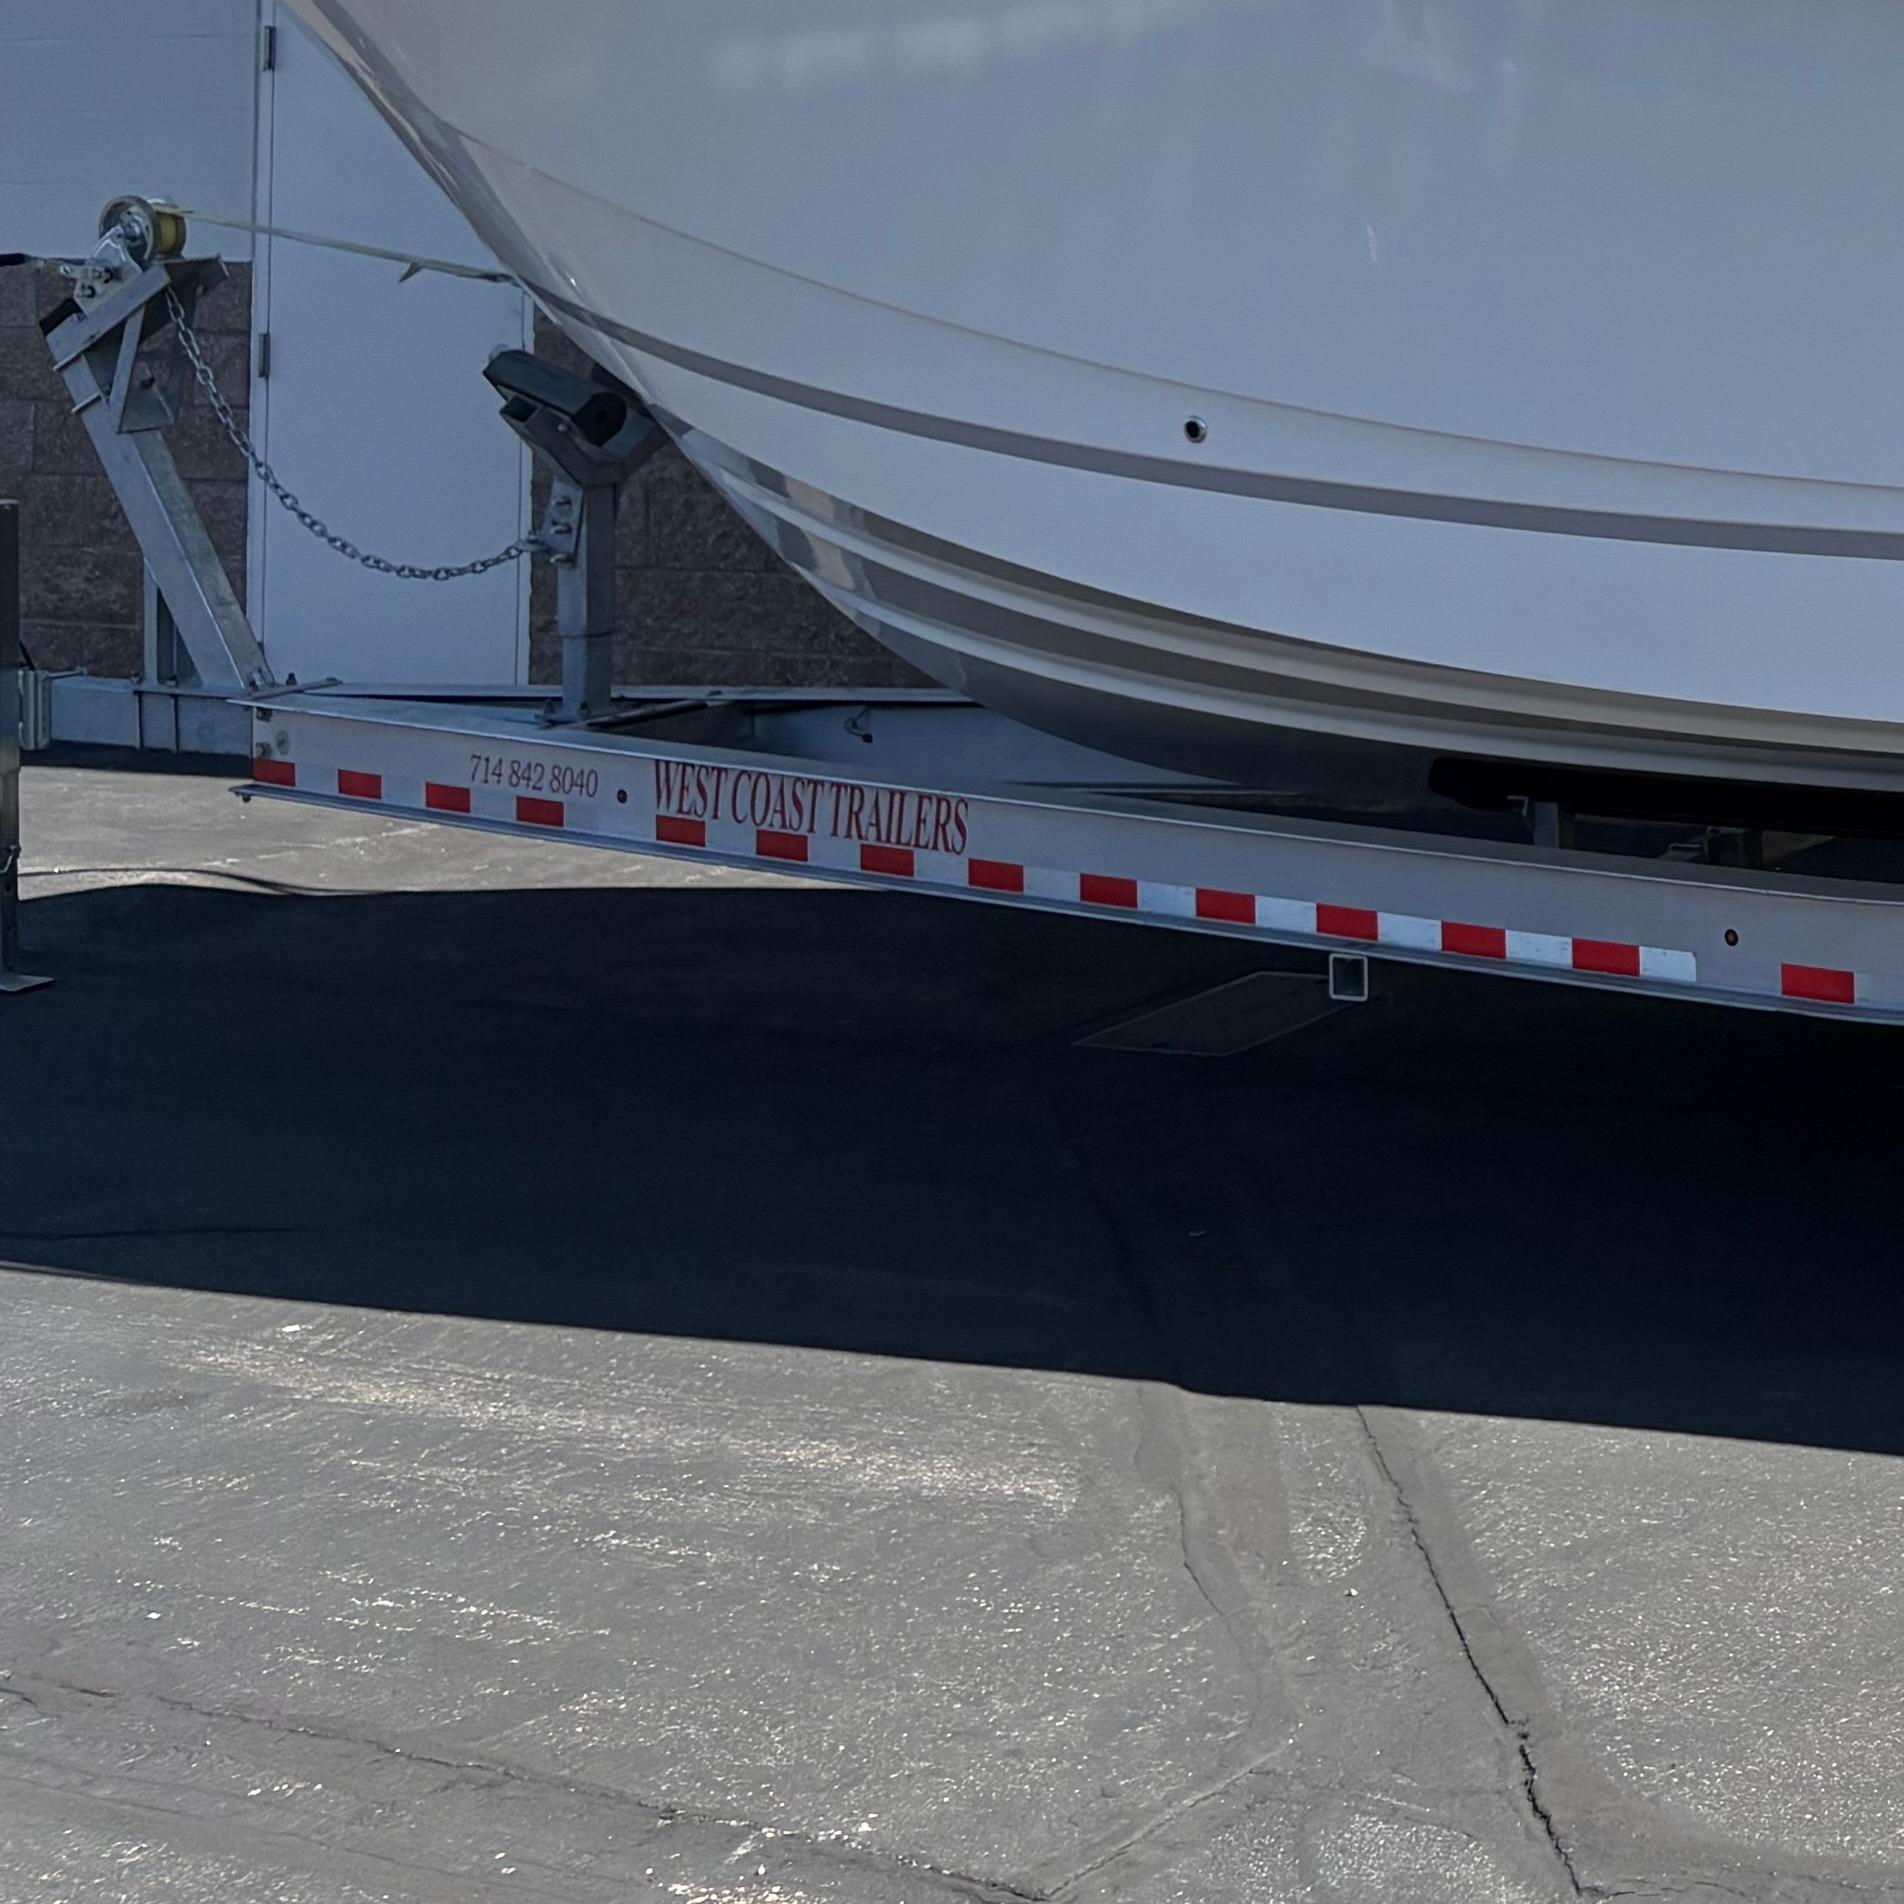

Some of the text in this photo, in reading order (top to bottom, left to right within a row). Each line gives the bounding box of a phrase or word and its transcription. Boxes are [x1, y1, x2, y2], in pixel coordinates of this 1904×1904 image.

[470, 754, 599, 798] 714 842 8040
[654, 759, 968, 855] WEST COAST TRAILERS
